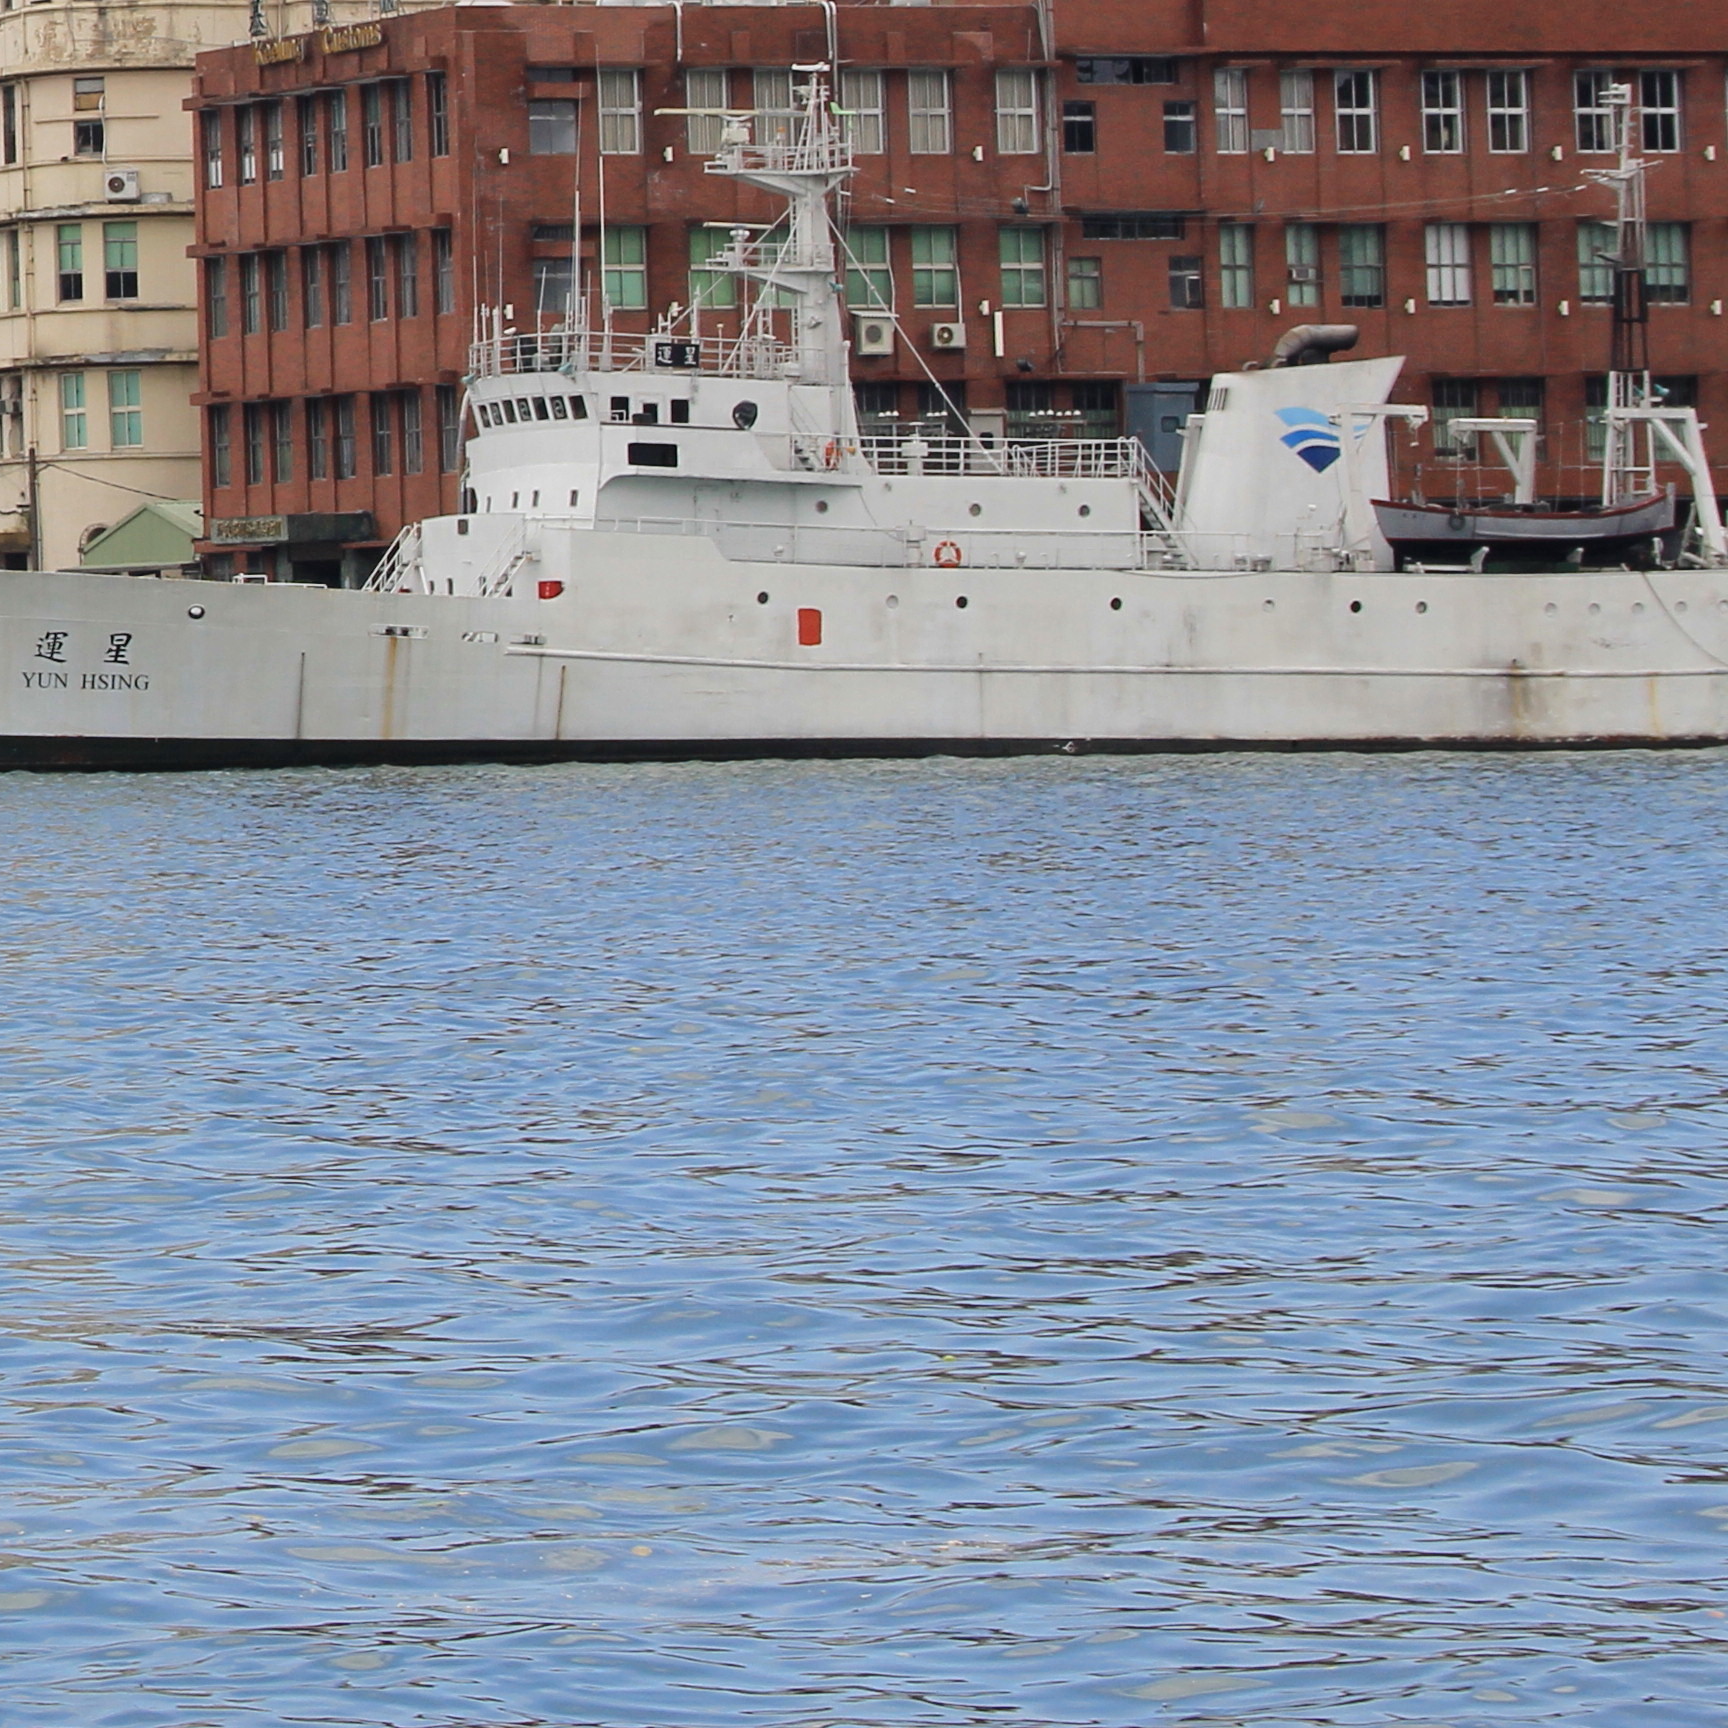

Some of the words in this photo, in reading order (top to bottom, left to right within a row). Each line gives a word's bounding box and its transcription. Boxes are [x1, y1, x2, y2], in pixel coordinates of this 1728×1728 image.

[321, 23, 382, 55] Customs
[22, 672, 68, 689] YUN
[81, 674, 150, 691] HSING
